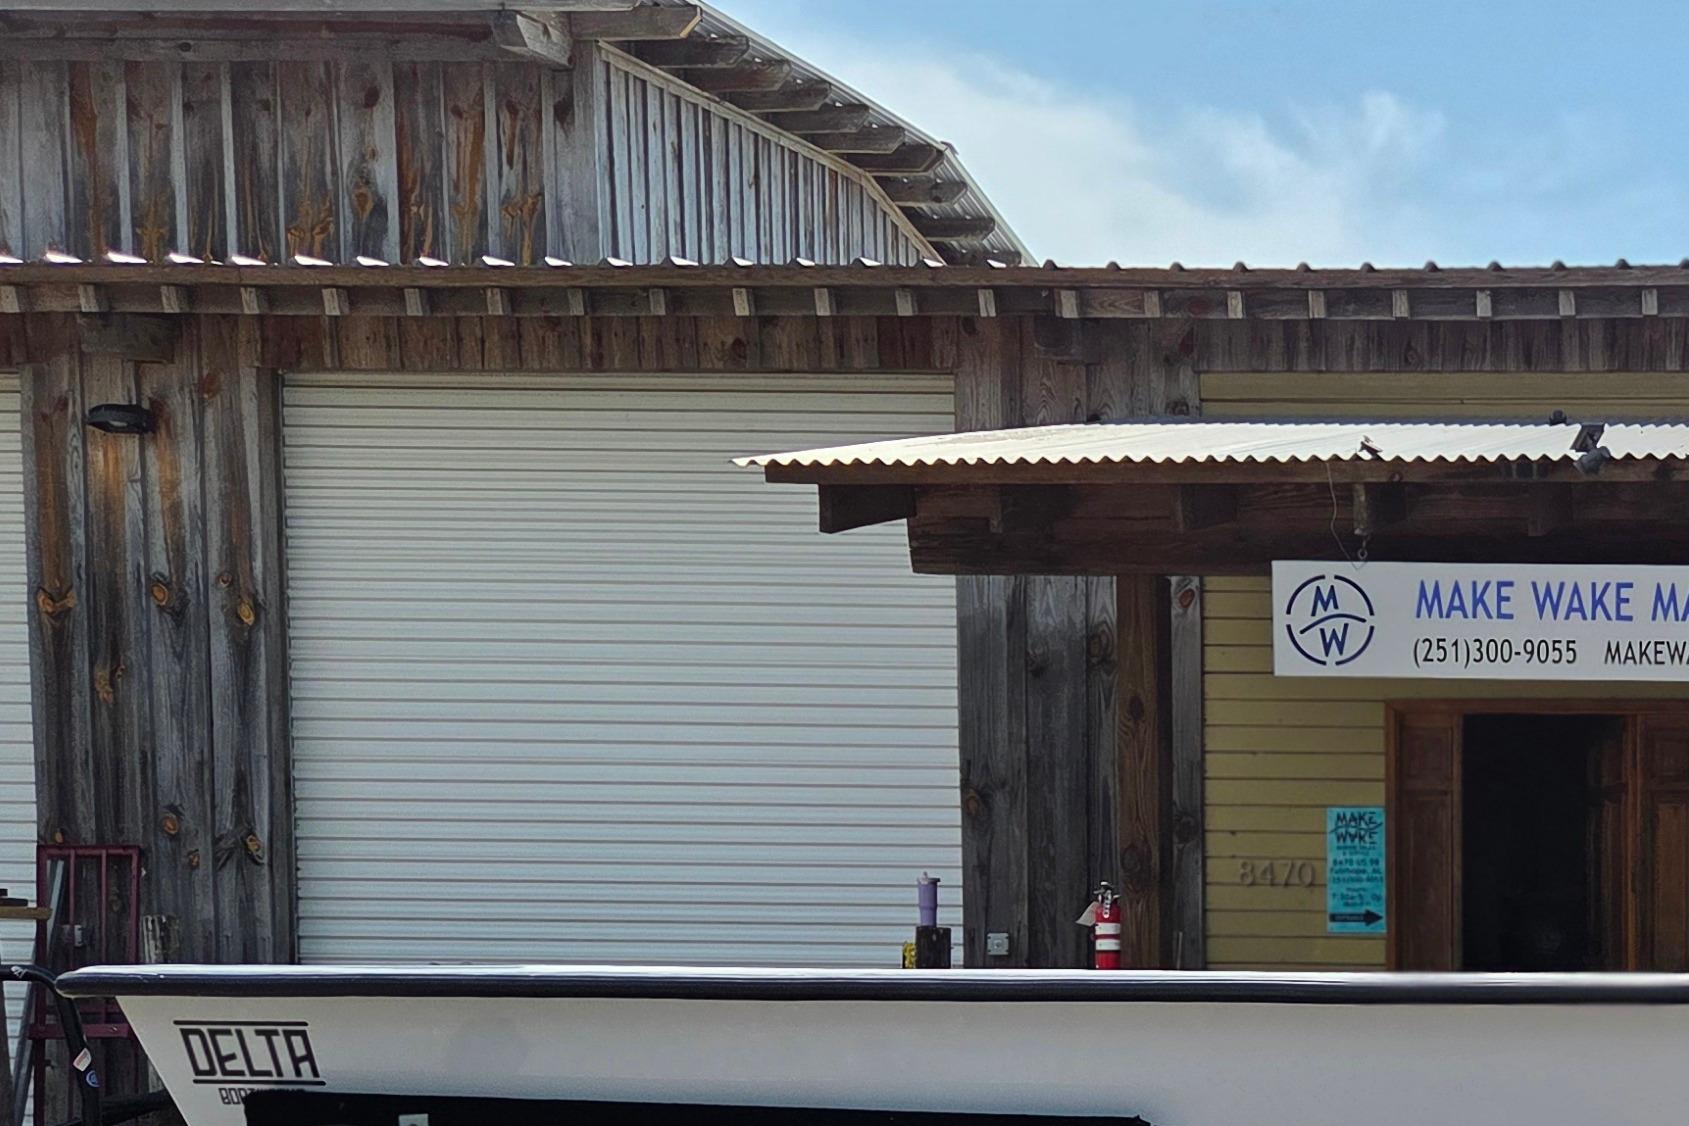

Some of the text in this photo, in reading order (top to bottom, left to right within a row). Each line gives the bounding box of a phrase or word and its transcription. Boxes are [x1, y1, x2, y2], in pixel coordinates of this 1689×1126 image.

[1416, 580, 1515, 620] MAKE
[1531, 581, 1634, 622] WAKE
[1413, 637, 1578, 668] (251)300-9055
[1239, 860, 1316, 889] 8470
[179, 1028, 320, 1078] DELTA
